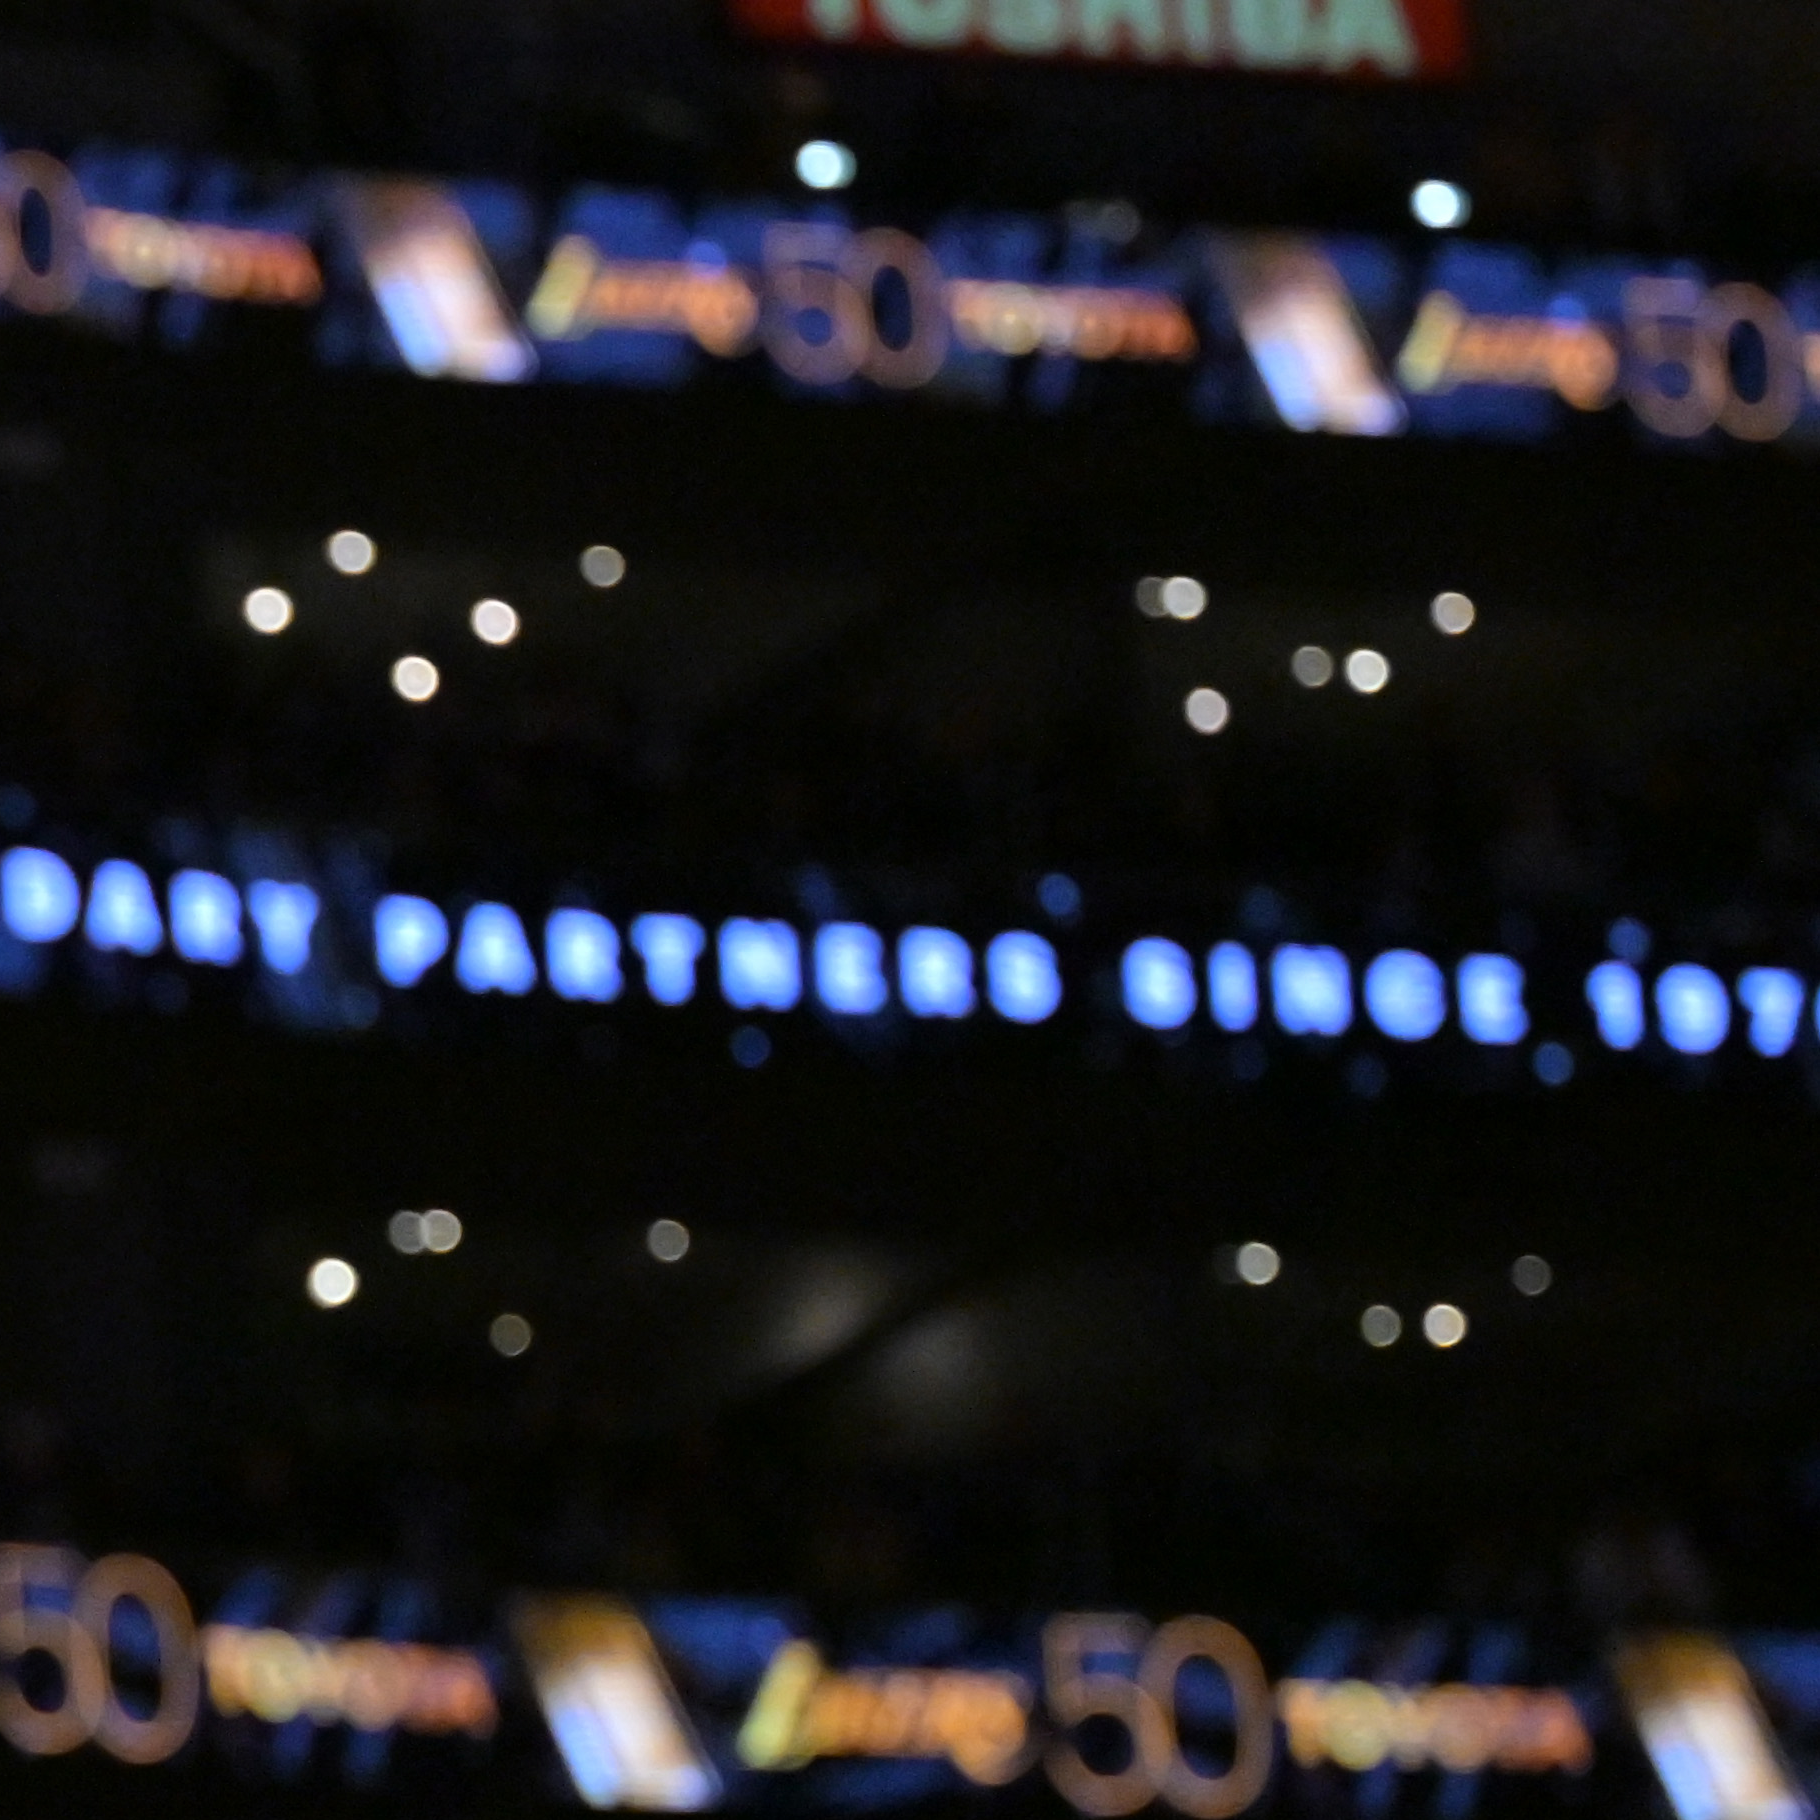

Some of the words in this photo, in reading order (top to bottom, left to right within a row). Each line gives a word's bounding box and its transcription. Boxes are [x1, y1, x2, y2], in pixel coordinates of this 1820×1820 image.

[374, 894, 1061, 1022] PARTNERS
[1122, 937, 1528, 1044] SINCE
[1587, 962, 1820, 1056] 197
